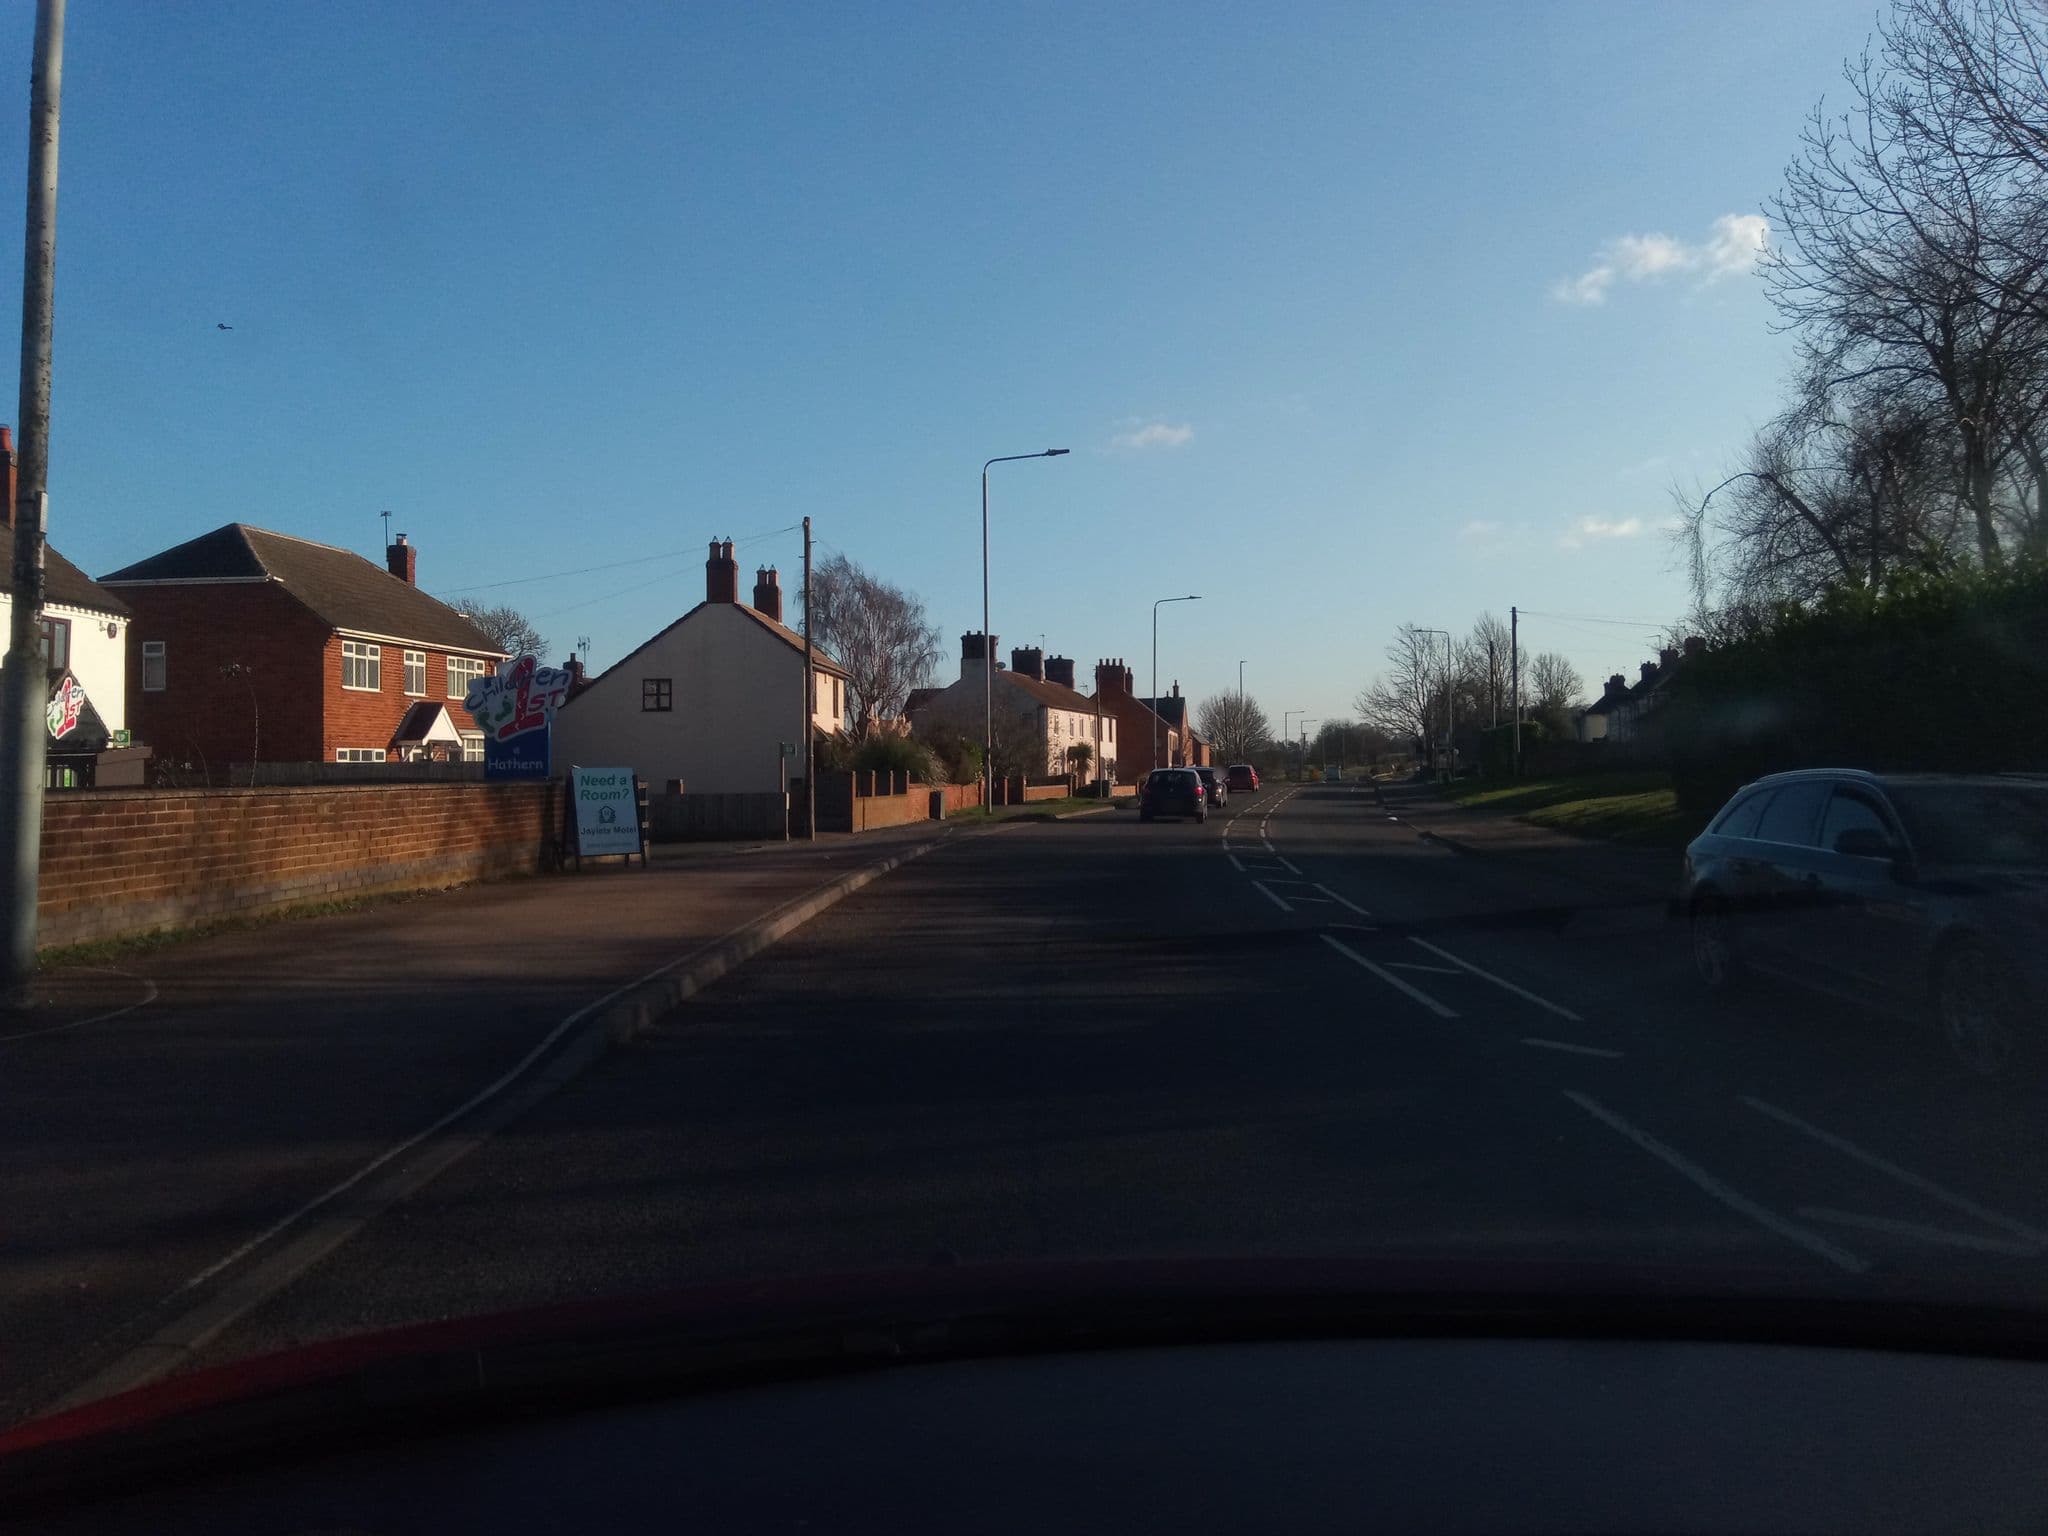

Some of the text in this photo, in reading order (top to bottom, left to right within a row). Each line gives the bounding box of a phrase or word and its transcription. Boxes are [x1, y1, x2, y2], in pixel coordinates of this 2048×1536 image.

[488, 757, 544, 771] Hathern
[580, 774, 627, 786] Need a
[580, 788, 629, 800] Room?
